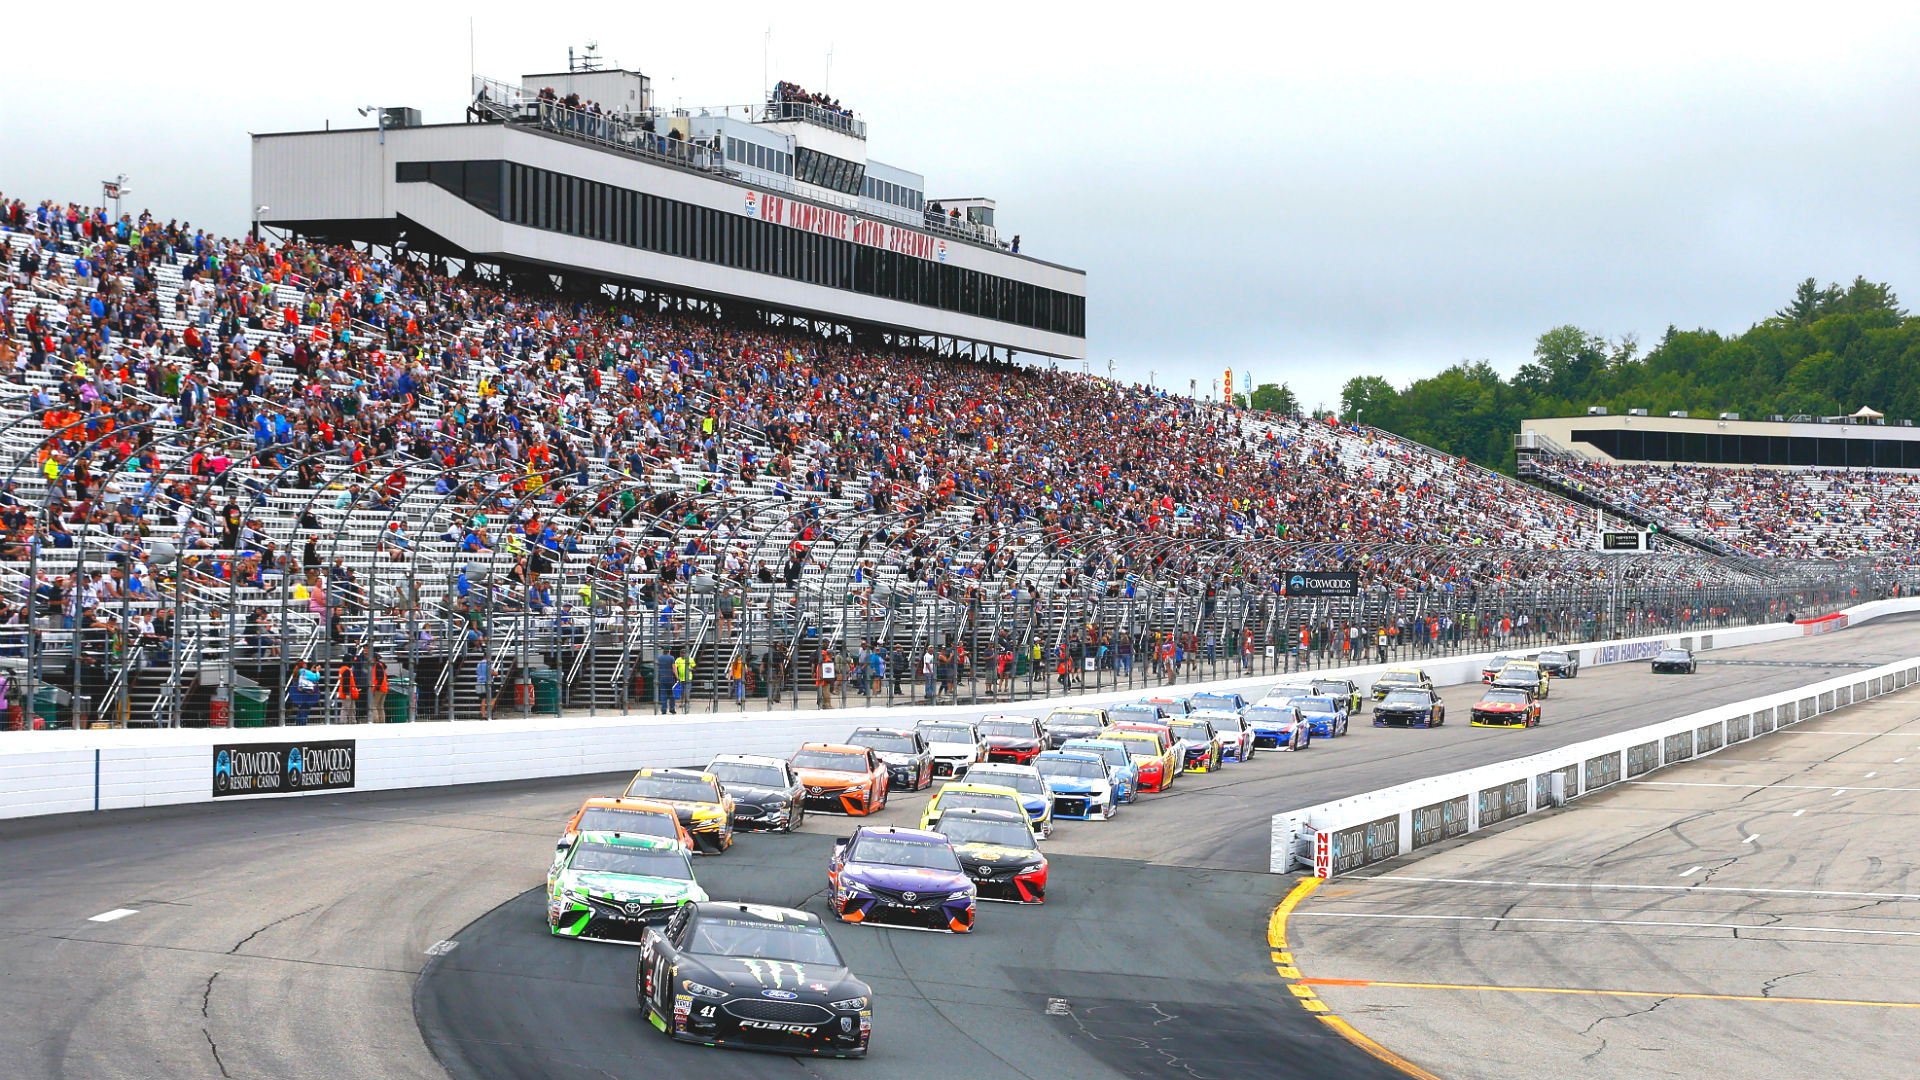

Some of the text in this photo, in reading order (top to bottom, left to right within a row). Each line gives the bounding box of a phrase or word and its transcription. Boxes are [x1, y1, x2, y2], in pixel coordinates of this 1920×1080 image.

[761, 194, 783, 224] NEW
[789, 201, 847, 239] HAMPSHIRE
[852, 219, 885, 249] MOTOR
[889, 226, 935, 260] SPEEDWAY
[1305, 577, 1352, 589] FOXWOODS
[1602, 645, 1619, 662] NEW
[230, 746, 352, 776] FOXWOODS FOXWOODS
[230, 770, 351, 790] RESORT CASINO RESORT CASINO
[1316, 832, 1329, 878] NHMS
[847, 890, 858, 900] 11
[563, 902, 574, 911] 18
[766, 989, 793, 999] Ford
[699, 1005, 717, 1018] 41
[738, 1020, 818, 1034] FUSION
